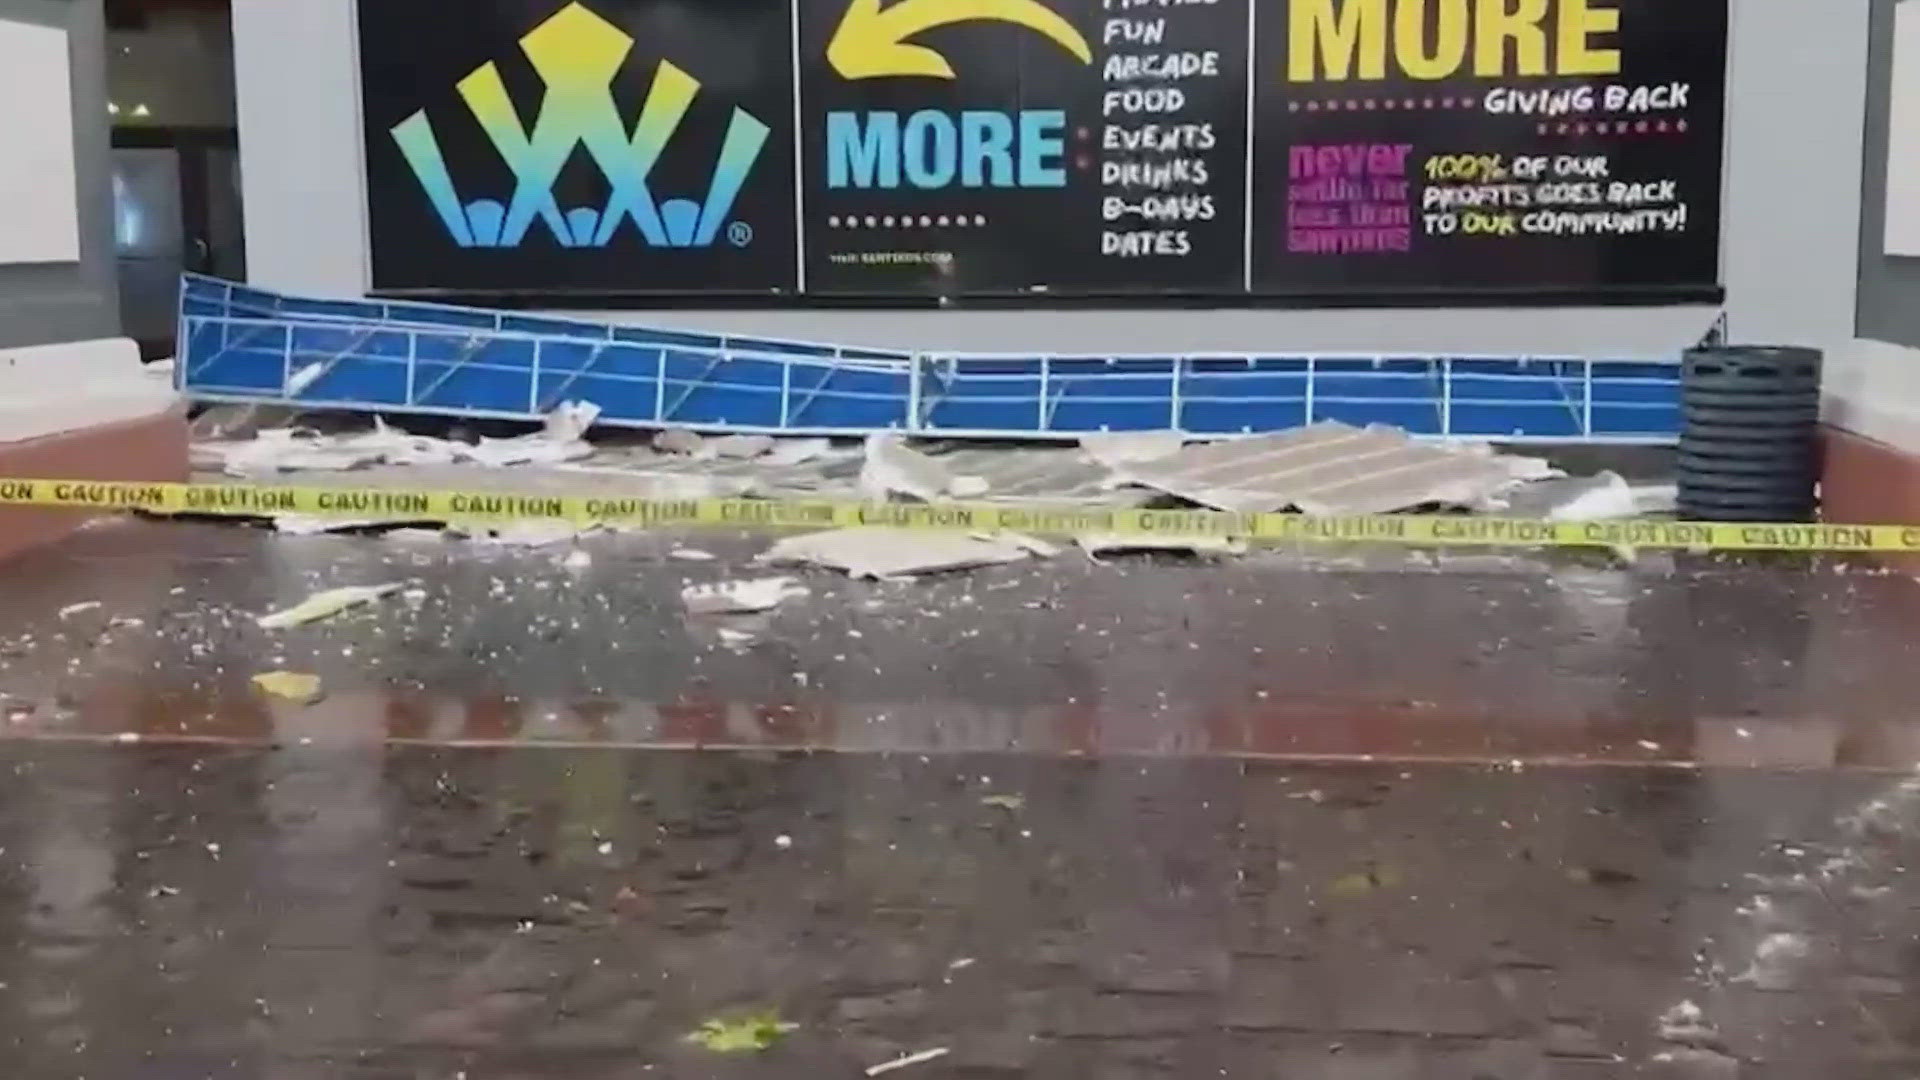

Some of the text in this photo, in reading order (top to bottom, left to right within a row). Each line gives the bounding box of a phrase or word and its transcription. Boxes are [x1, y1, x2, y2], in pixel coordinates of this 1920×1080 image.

[1103, 18, 1165, 45] FUN
[1288, 0, 1622, 82] MORE
[1103, 51, 1219, 81] ARCADE
[1102, 88, 1185, 117] FOOD
[1484, 82, 1690, 116] GIVING BACK
[1102, 123, 1216, 152] EVENTS
[1102, 157, 1210, 190] DRINKS
[1288, 144, 1413, 178] never
[1424, 154, 1610, 182] 100% OF OUR
[1102, 194, 1217, 221] B-DAYS
[1423, 179, 1677, 210] PROFITS GOES BACK
[1423, 203, 1688, 236] TO OUR COMMUNITY!
[1102, 230, 1191, 257] DATES
[55, 484, 163, 504] CAUTION
[185, 487, 296, 510] CAUTION
[318, 491, 429, 513] CAUTION
[450, 496, 562, 517] CAUTION
[585, 499, 697, 521] CAUTION
[1431, 519, 1556, 542] CAUTION
[1584, 521, 1713, 544] CAUTION
[1742, 526, 1873, 547] CAUTION
